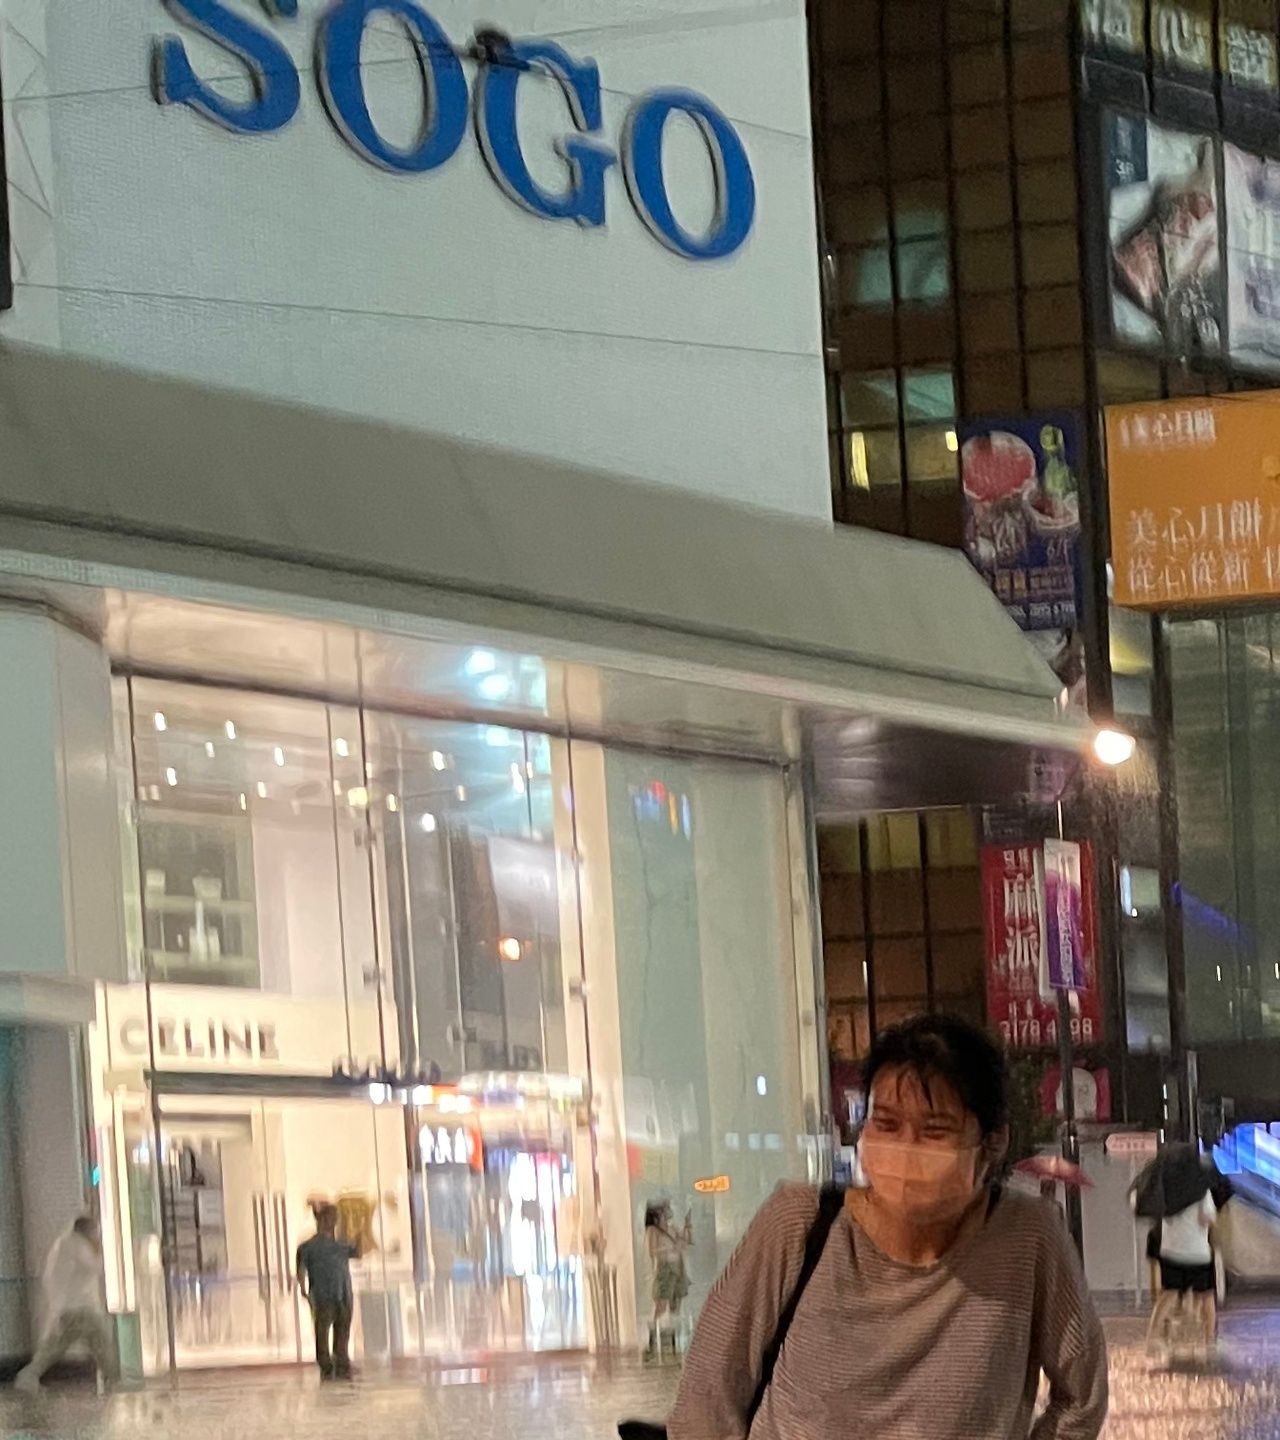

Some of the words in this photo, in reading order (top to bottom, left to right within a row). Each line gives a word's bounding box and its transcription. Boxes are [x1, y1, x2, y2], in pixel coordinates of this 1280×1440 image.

[155, 0, 757, 260] SOGO
[1129, 497, 1263, 550] 美心月餅
[120, 1018, 280, 1061] CELINE
